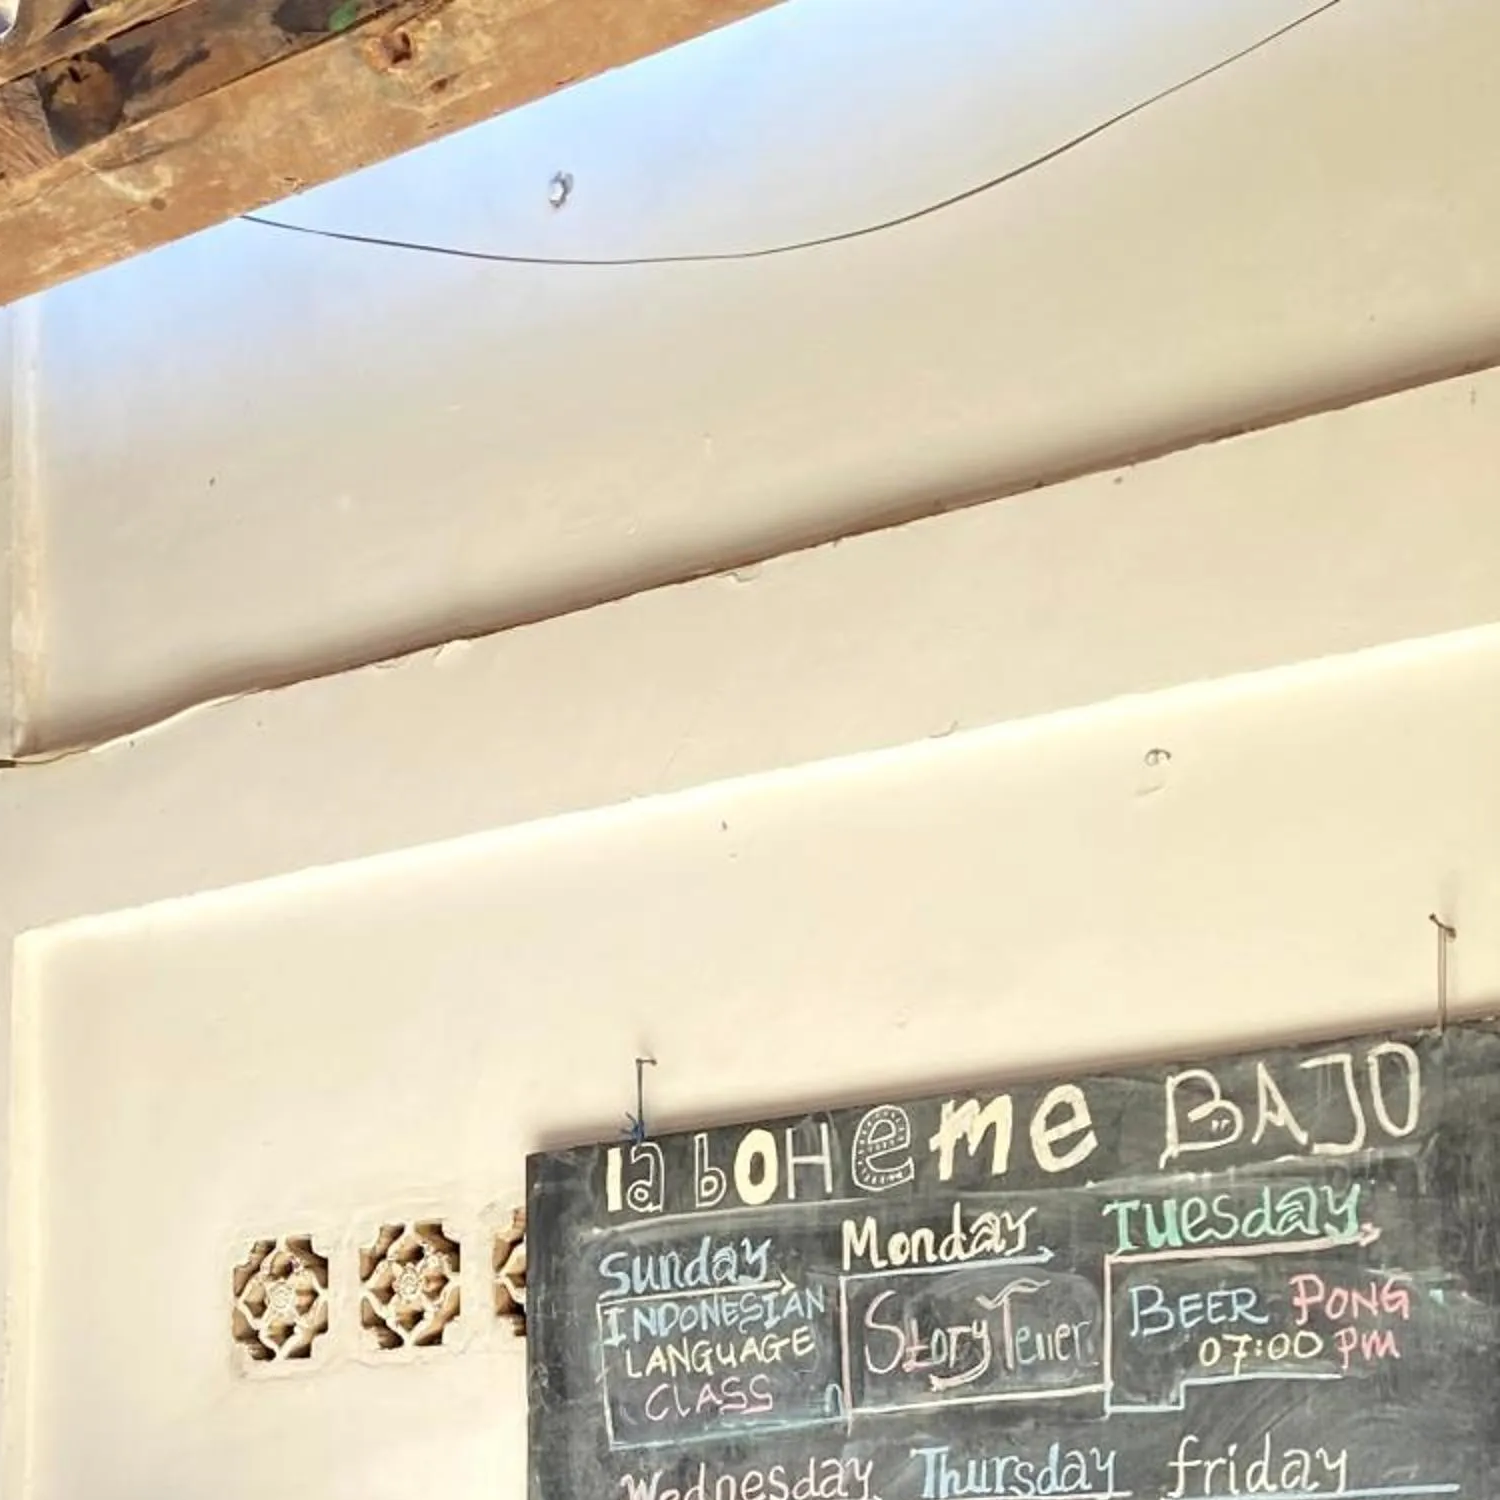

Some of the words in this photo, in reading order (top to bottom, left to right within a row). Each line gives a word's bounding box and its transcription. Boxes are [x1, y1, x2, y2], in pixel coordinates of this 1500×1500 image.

[1160, 1042, 1422, 1168] BAJO
[600, 1236, 773, 1295] Sunday
[842, 1201, 1038, 1271] Monday
[604, 1284, 825, 1346] INDONESIAN
[1129, 1284, 1268, 1336] BEER
[1289, 1274, 1411, 1325] PONG
[1198, 1331, 1324, 1374] 07:00
[910, 1442, 1117, 1500] Thursday
